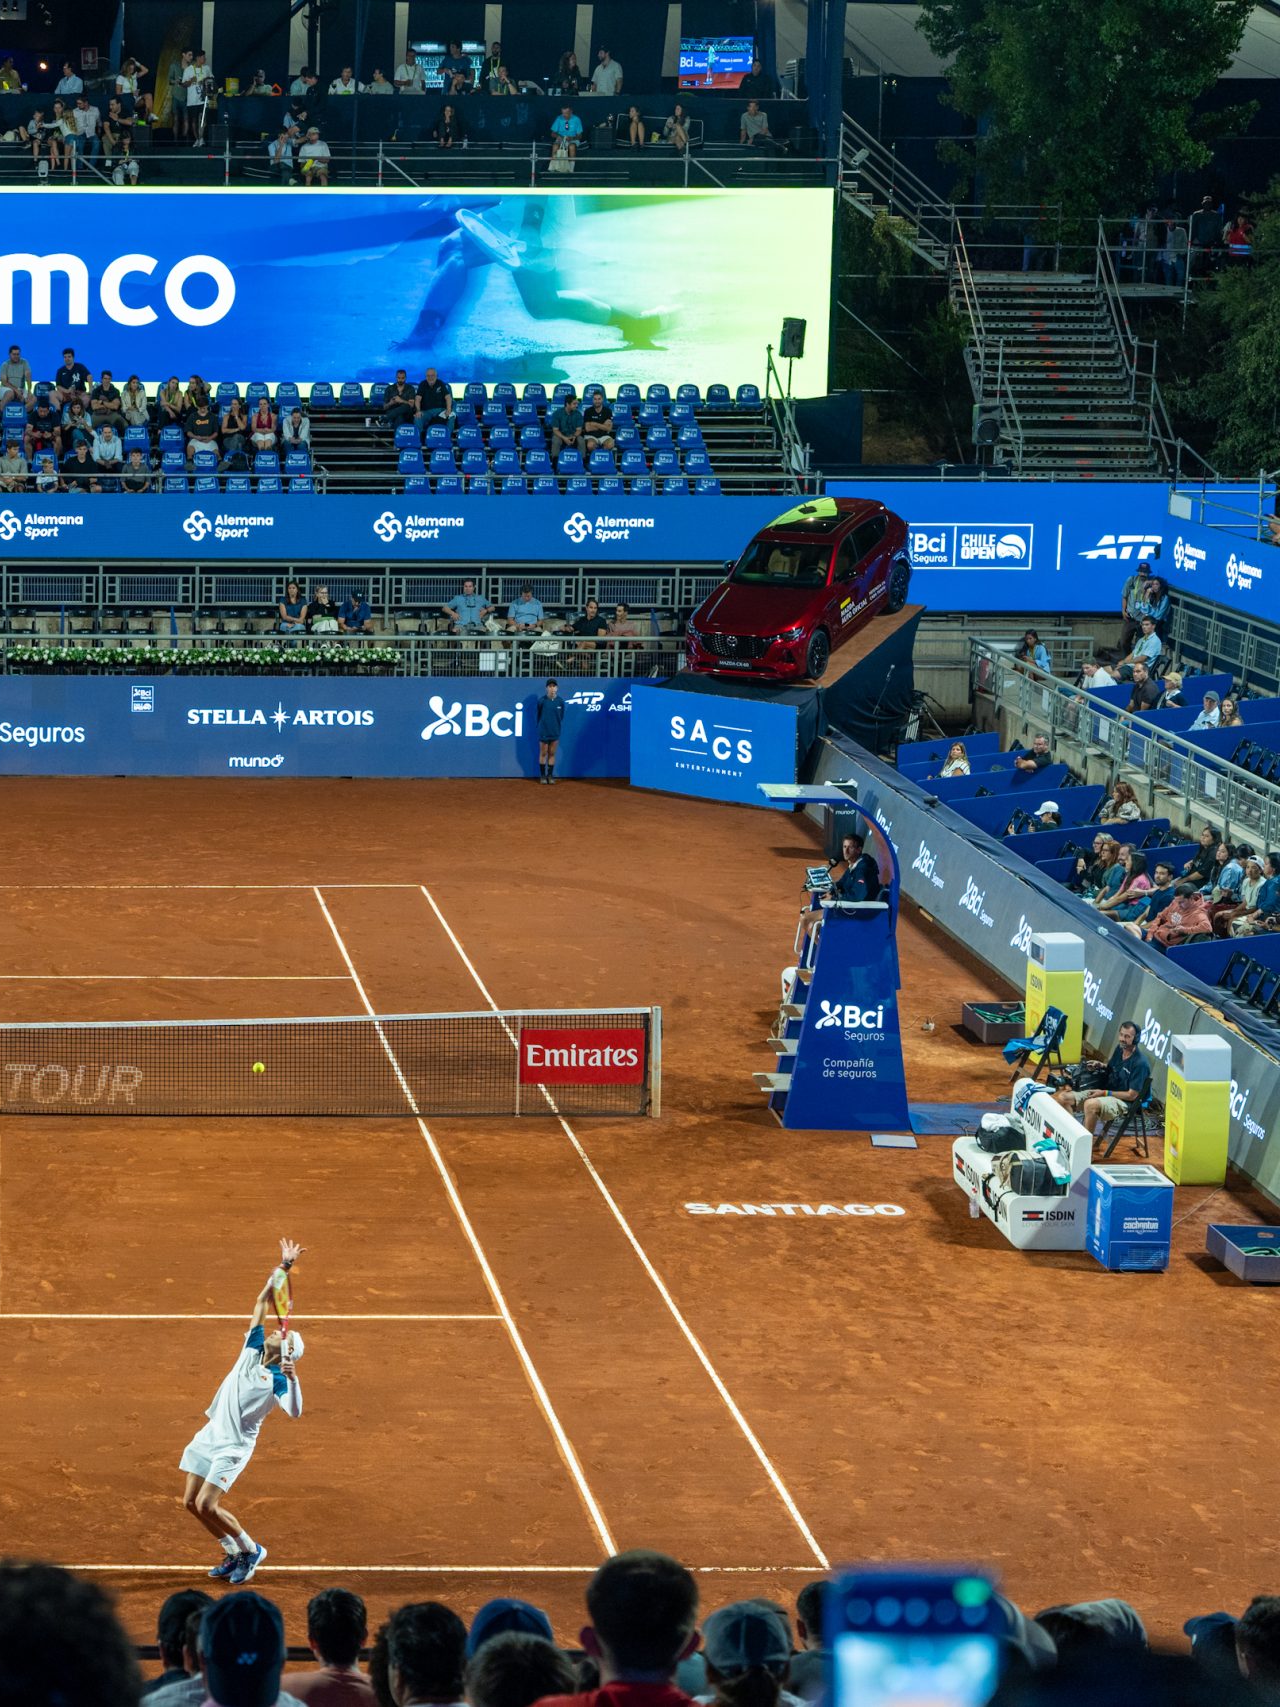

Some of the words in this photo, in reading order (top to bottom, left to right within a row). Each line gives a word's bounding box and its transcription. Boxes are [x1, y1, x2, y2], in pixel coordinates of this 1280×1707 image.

[24, 513, 83, 525] Alemana
[214, 514, 273, 526] Alemana
[405, 515, 464, 527] Alemana
[595, 516, 654, 528] Alemana
[24, 525, 59, 540] Sport
[214, 526, 249, 541] Sport
[405, 527, 440, 542] Sport
[595, 528, 630, 543] Sport
[914, 532, 946, 552] Bci
[961, 534, 997, 547] CHILE
[1077, 535, 1163, 560] ATP
[913, 553, 948, 564] Seguros
[961, 547, 996, 560] OPEN
[1184, 543, 1206, 561] Alemana
[1184, 557, 1197, 571] Sport
[1238, 561, 1262, 579] Alemana
[1238, 576, 1251, 590] Sport
[564, 691, 604, 704] ATP
[586, 704, 602, 712] 250
[608, 704, 632, 712] ASH
[187, 708, 268, 726] STELLA
[292, 708, 375, 726] ARTOIS
[465, 703, 523, 738] Bci
[0, 722, 85, 748] Seguros
[675, 762, 744, 778] ENTERTAINMENT
[967, 886, 987, 916] Bci
[844, 1004, 884, 1029] Bci
[844, 1030, 885, 1043] Seguros
[1147, 1020, 1172, 1060] Bci
[526, 1043, 638, 1067] Emirates
[823, 1058, 874, 1069] Compañía
[822, 1069, 835, 1078] de
[837, 1070, 877, 1080] seguros
[4, 1063, 143, 1105] TOUR
[1024, 1105, 1042, 1133] ISDIN
[1243, 1113, 1266, 1140] Seguros
[685, 1202, 907, 1218] SANTIAGO
[1045, 1210, 1075, 1221] ISDIN
